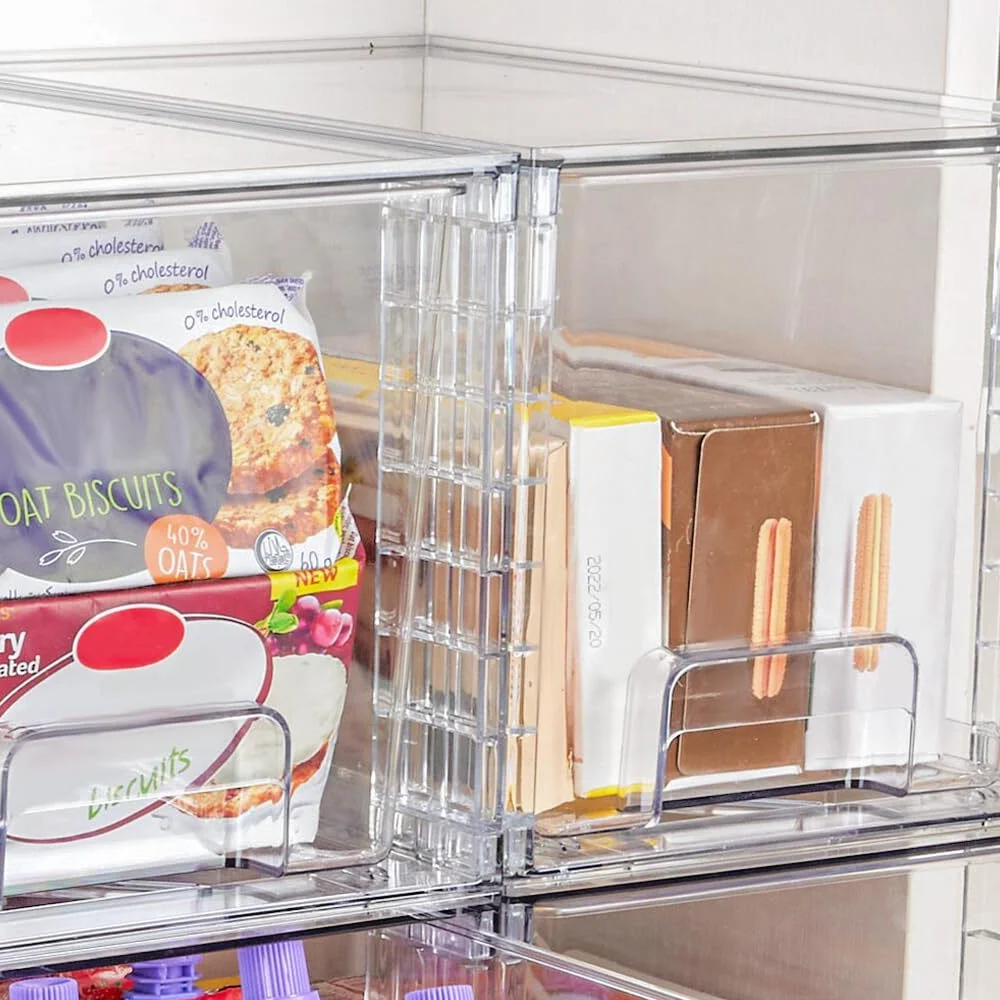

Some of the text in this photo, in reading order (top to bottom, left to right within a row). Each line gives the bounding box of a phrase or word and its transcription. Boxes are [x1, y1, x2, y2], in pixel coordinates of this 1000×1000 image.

[104, 261, 209, 295] 0% cholesterol
[184, 301, 286, 330] 0% cholesterol
[63, 471, 182, 520] BISCUITS
[166, 524, 209, 550] 40%
[158, 547, 213, 580] OATS
[295, 565, 338, 587] NEW
[587, 554, 602, 648] 2022/05/20
